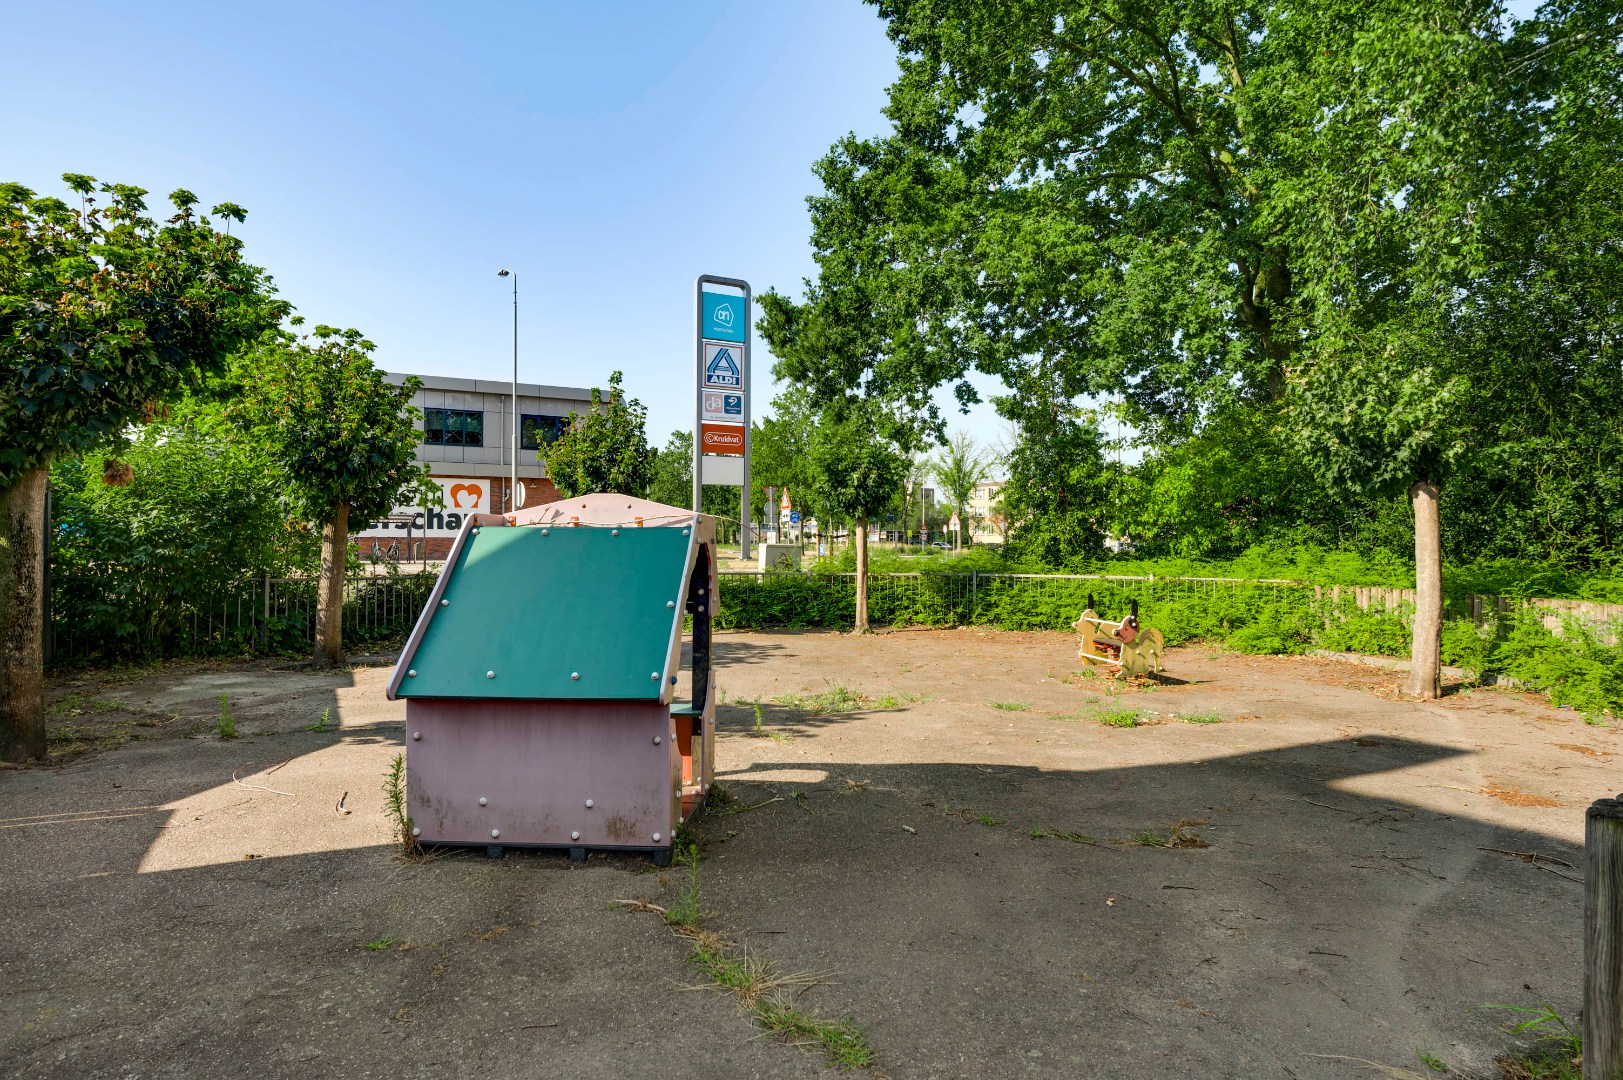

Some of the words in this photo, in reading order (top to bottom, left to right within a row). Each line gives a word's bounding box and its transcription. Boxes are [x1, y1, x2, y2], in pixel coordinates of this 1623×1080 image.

[710, 375, 737, 385] ALDI
[705, 396, 722, 410] da
[713, 434, 739, 443] Kruidvat
